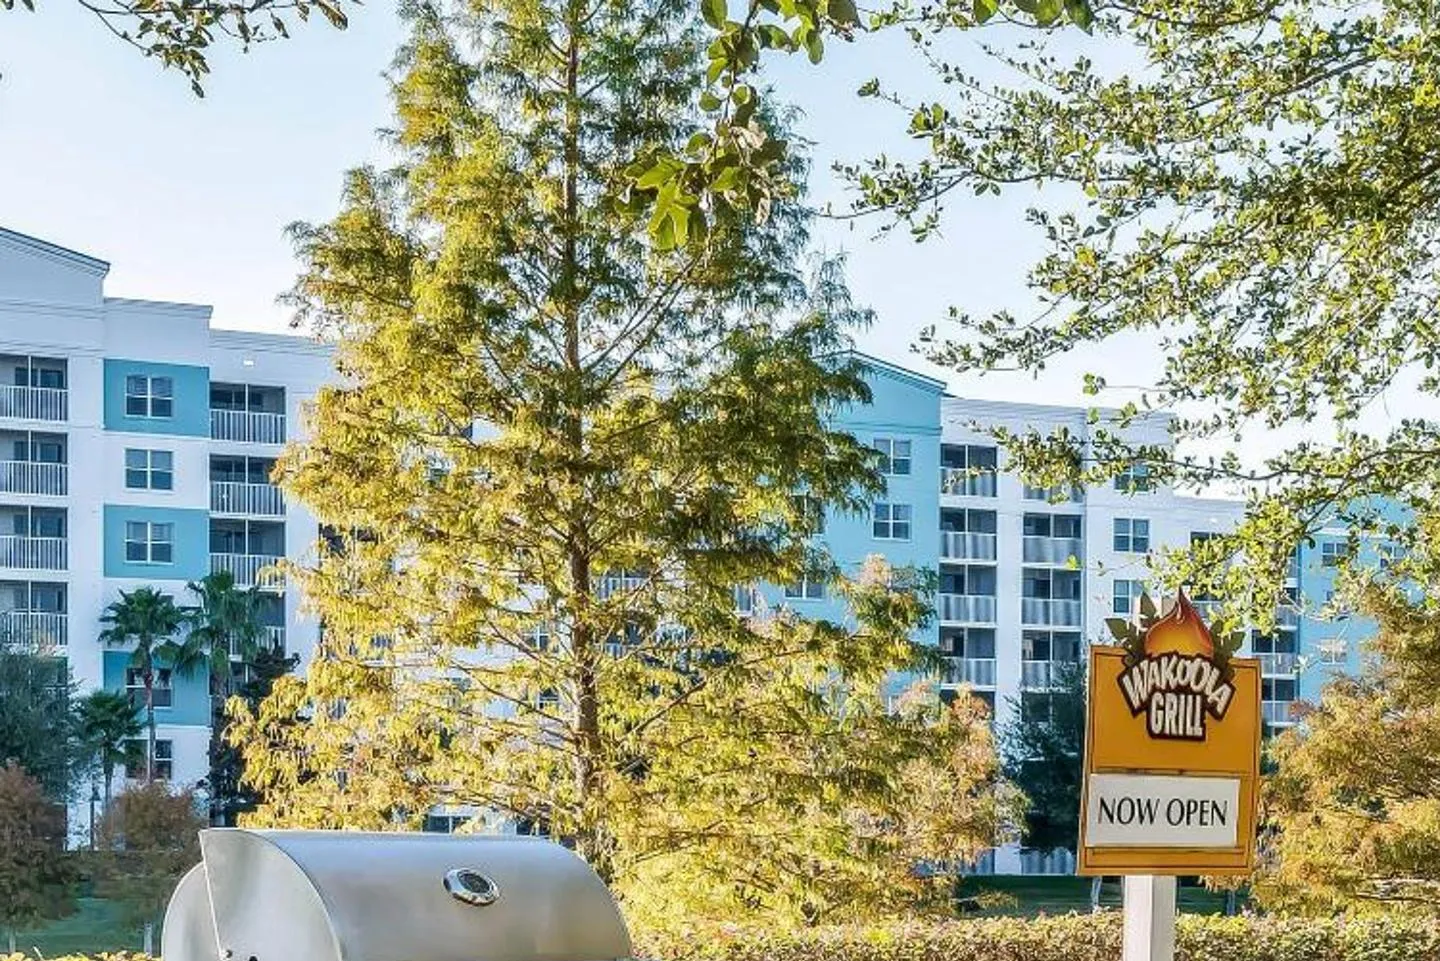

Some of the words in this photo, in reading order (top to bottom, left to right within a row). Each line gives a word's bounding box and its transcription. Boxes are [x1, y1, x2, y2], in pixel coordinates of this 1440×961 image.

[1150, 692, 1203, 736] GRILL
[1098, 797, 1160, 825] NOW
[1166, 798, 1227, 826] OPEN
